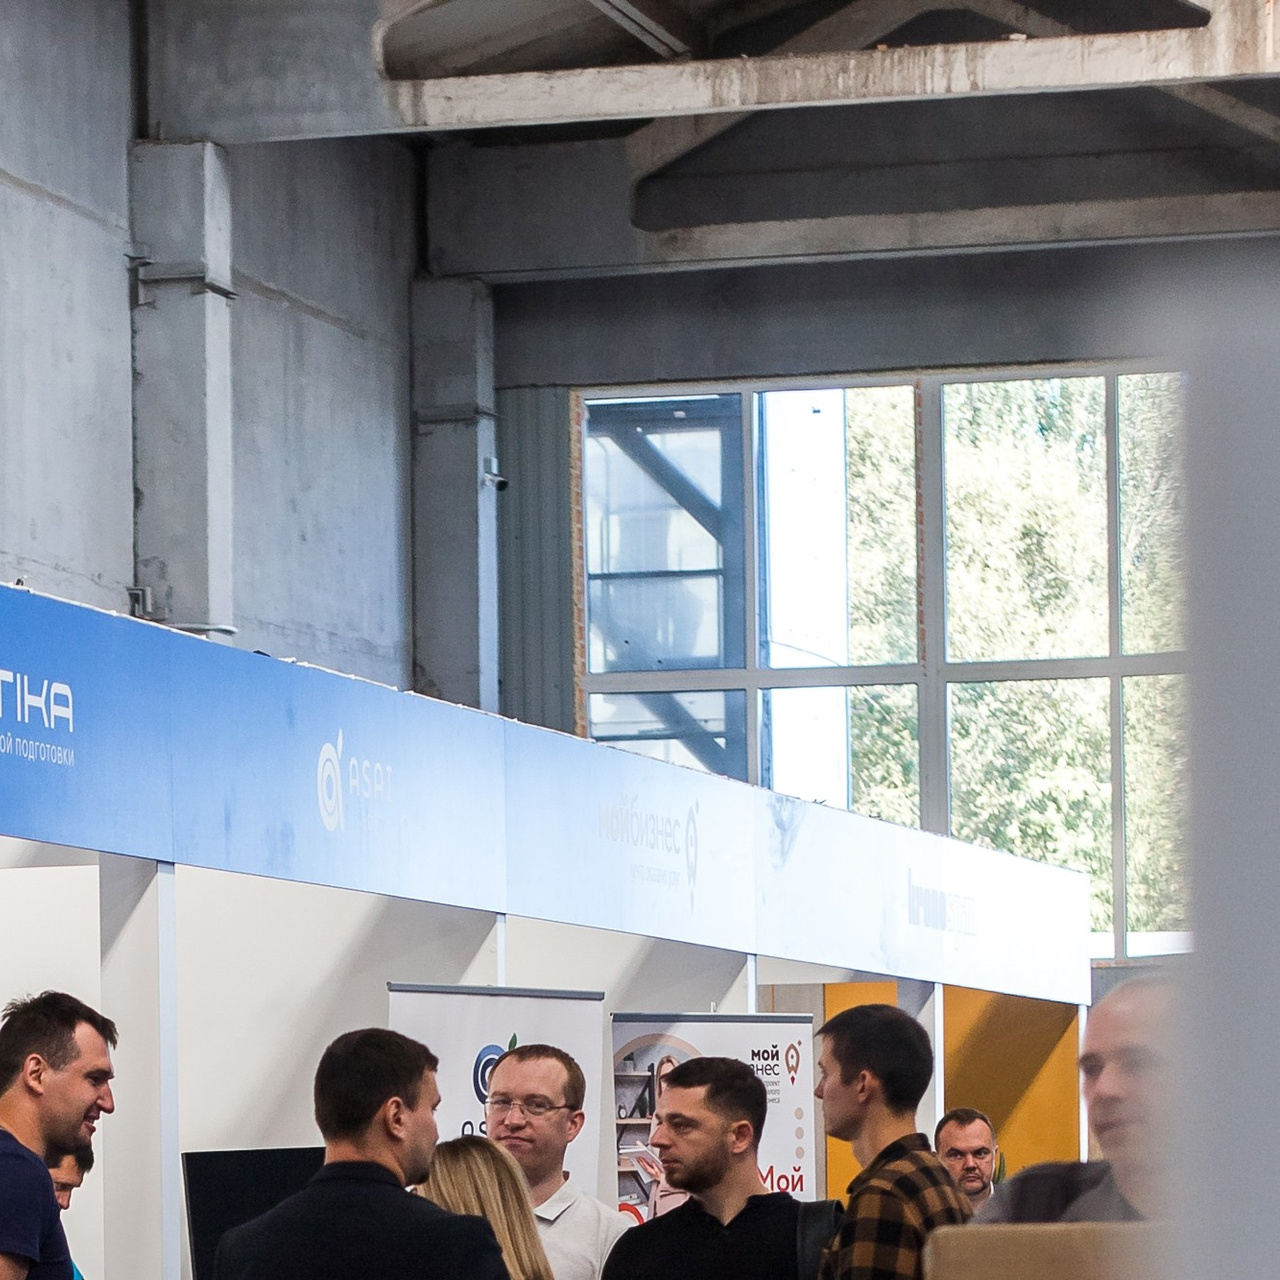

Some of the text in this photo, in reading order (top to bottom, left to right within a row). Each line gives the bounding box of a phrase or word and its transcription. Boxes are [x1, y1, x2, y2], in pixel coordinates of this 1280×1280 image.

[15, 738, 75, 766] ПОДГОТОВКИ
[348, 756, 394, 804] ASAI
[751, 1044, 780, 1061] мой
[757, 1165, 804, 1193] Мой
